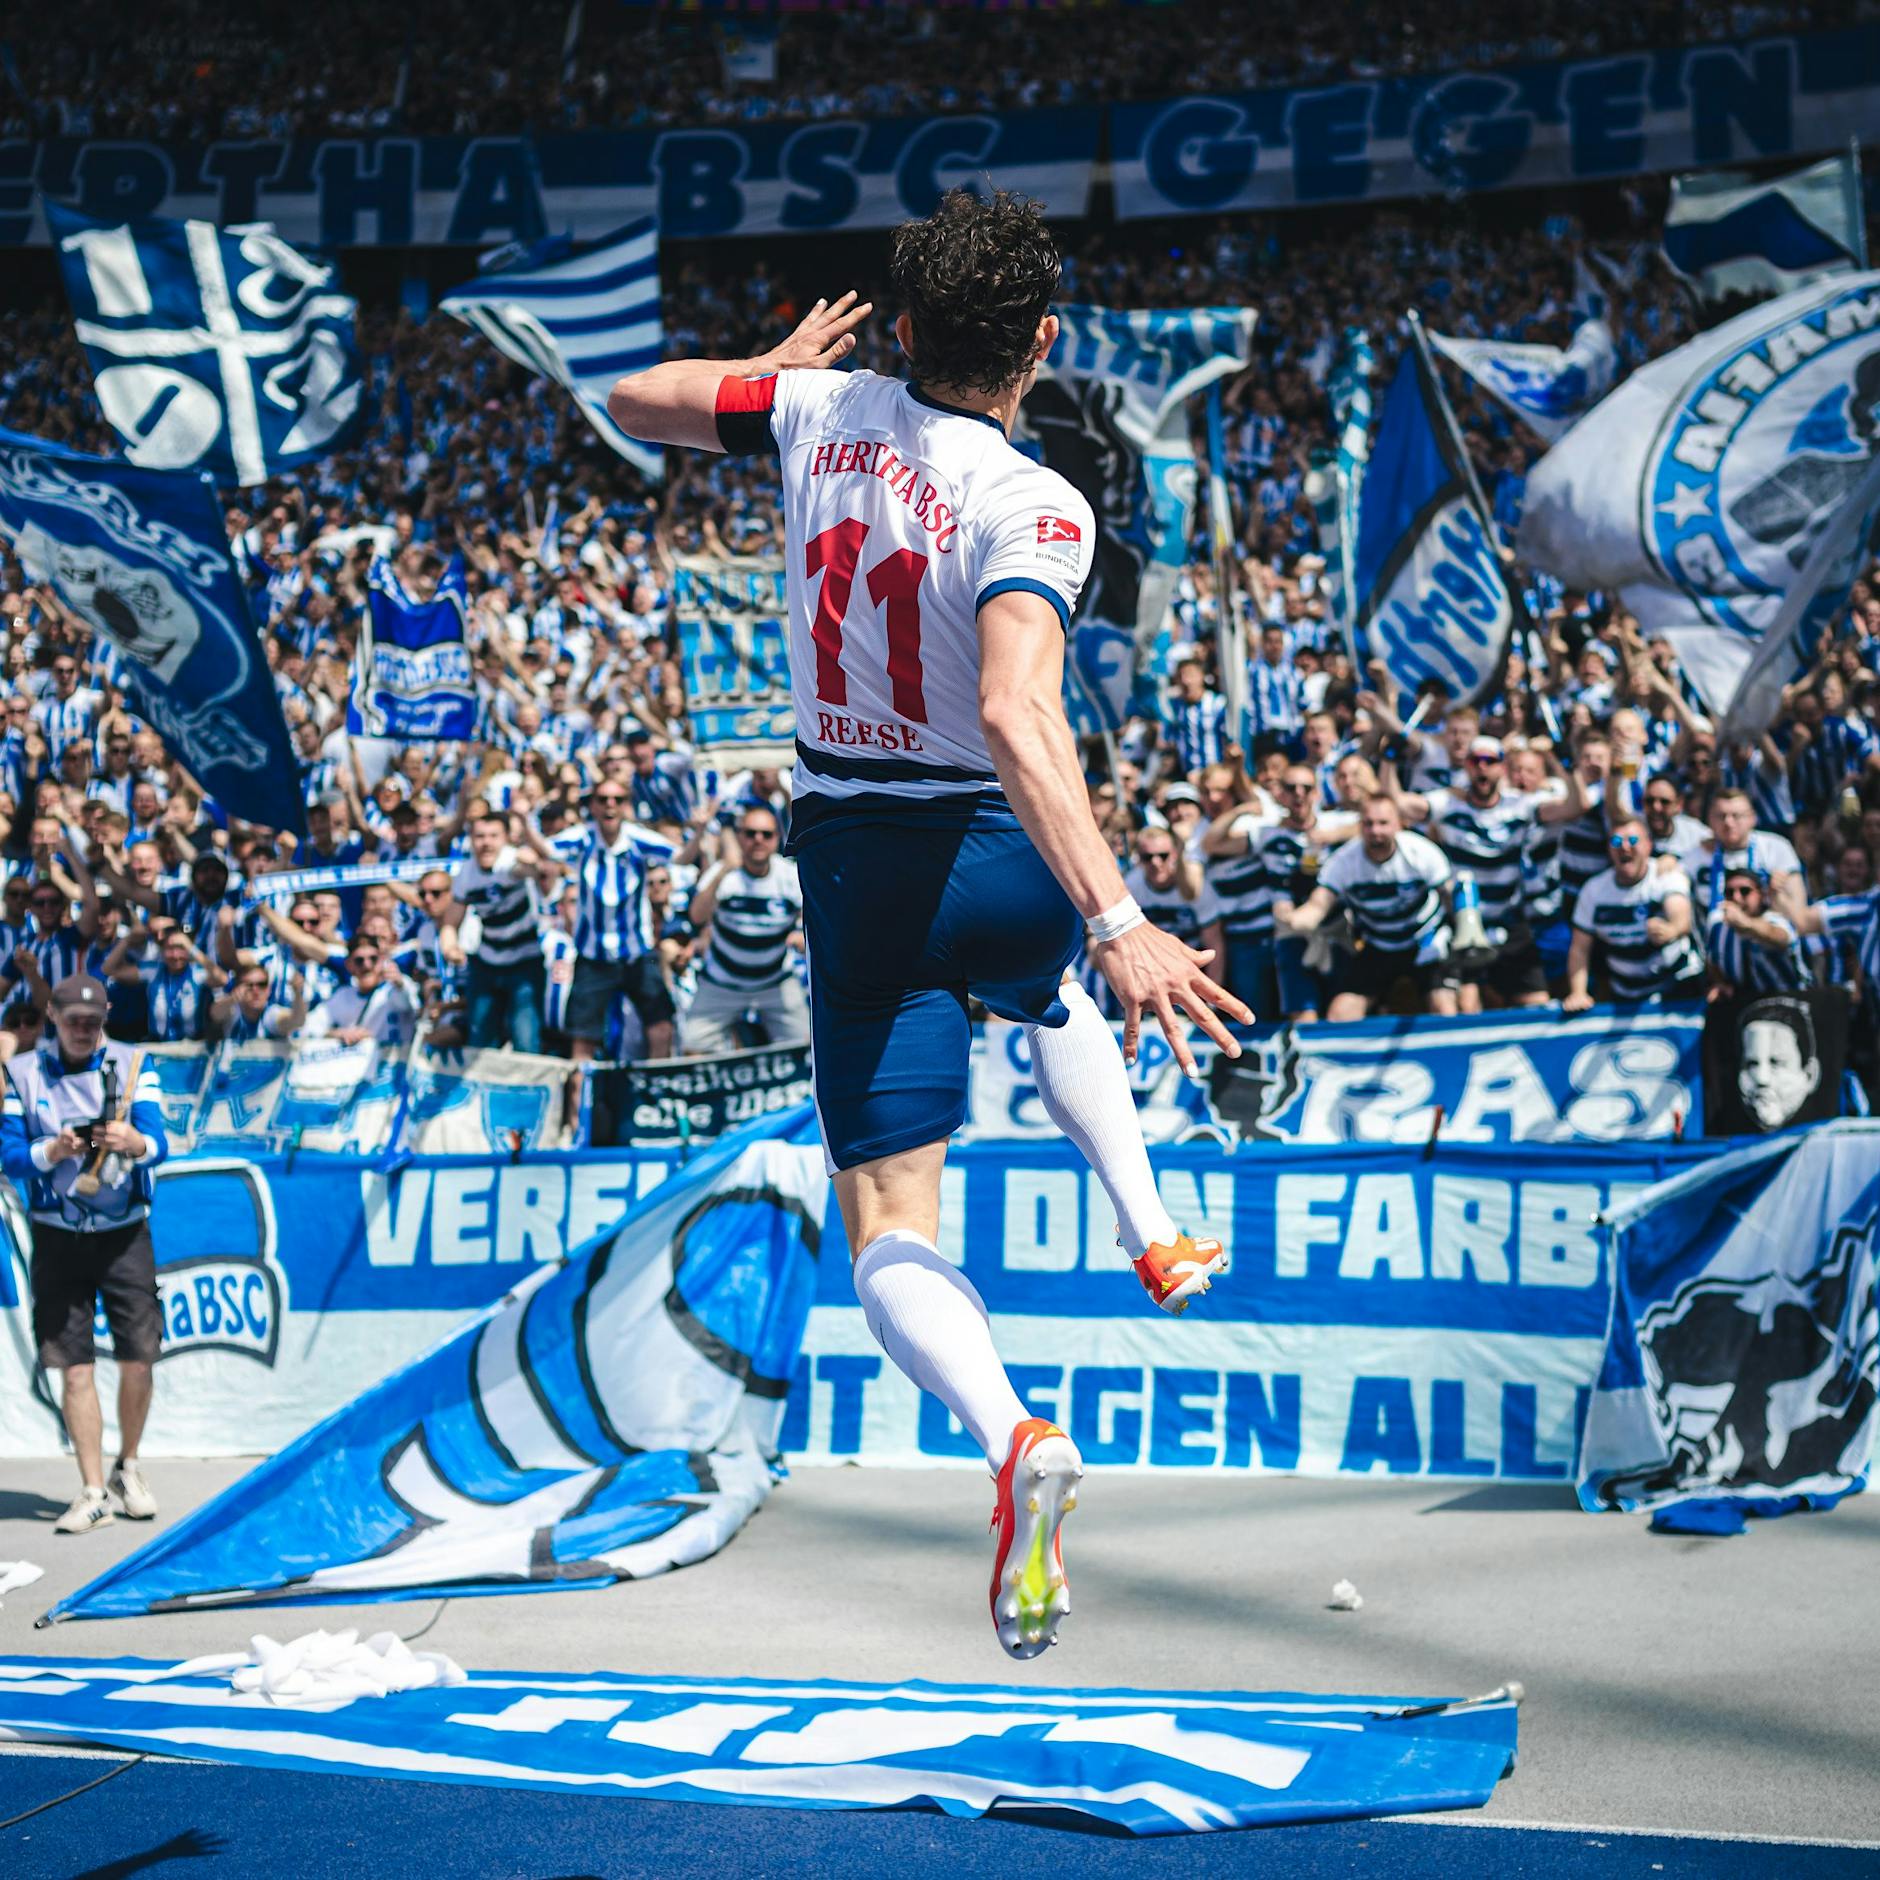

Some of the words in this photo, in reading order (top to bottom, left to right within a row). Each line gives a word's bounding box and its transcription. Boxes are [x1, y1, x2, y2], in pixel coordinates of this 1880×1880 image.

[652, 114, 1002, 236] BSC
[1142, 38, 1798, 210] GEGEN
[805, 516, 929, 725] 11
[817, 711, 924, 752] REESE
[1275, 1173, 1655, 1289] FARB
[1339, 1375, 1590, 1480] ALL
